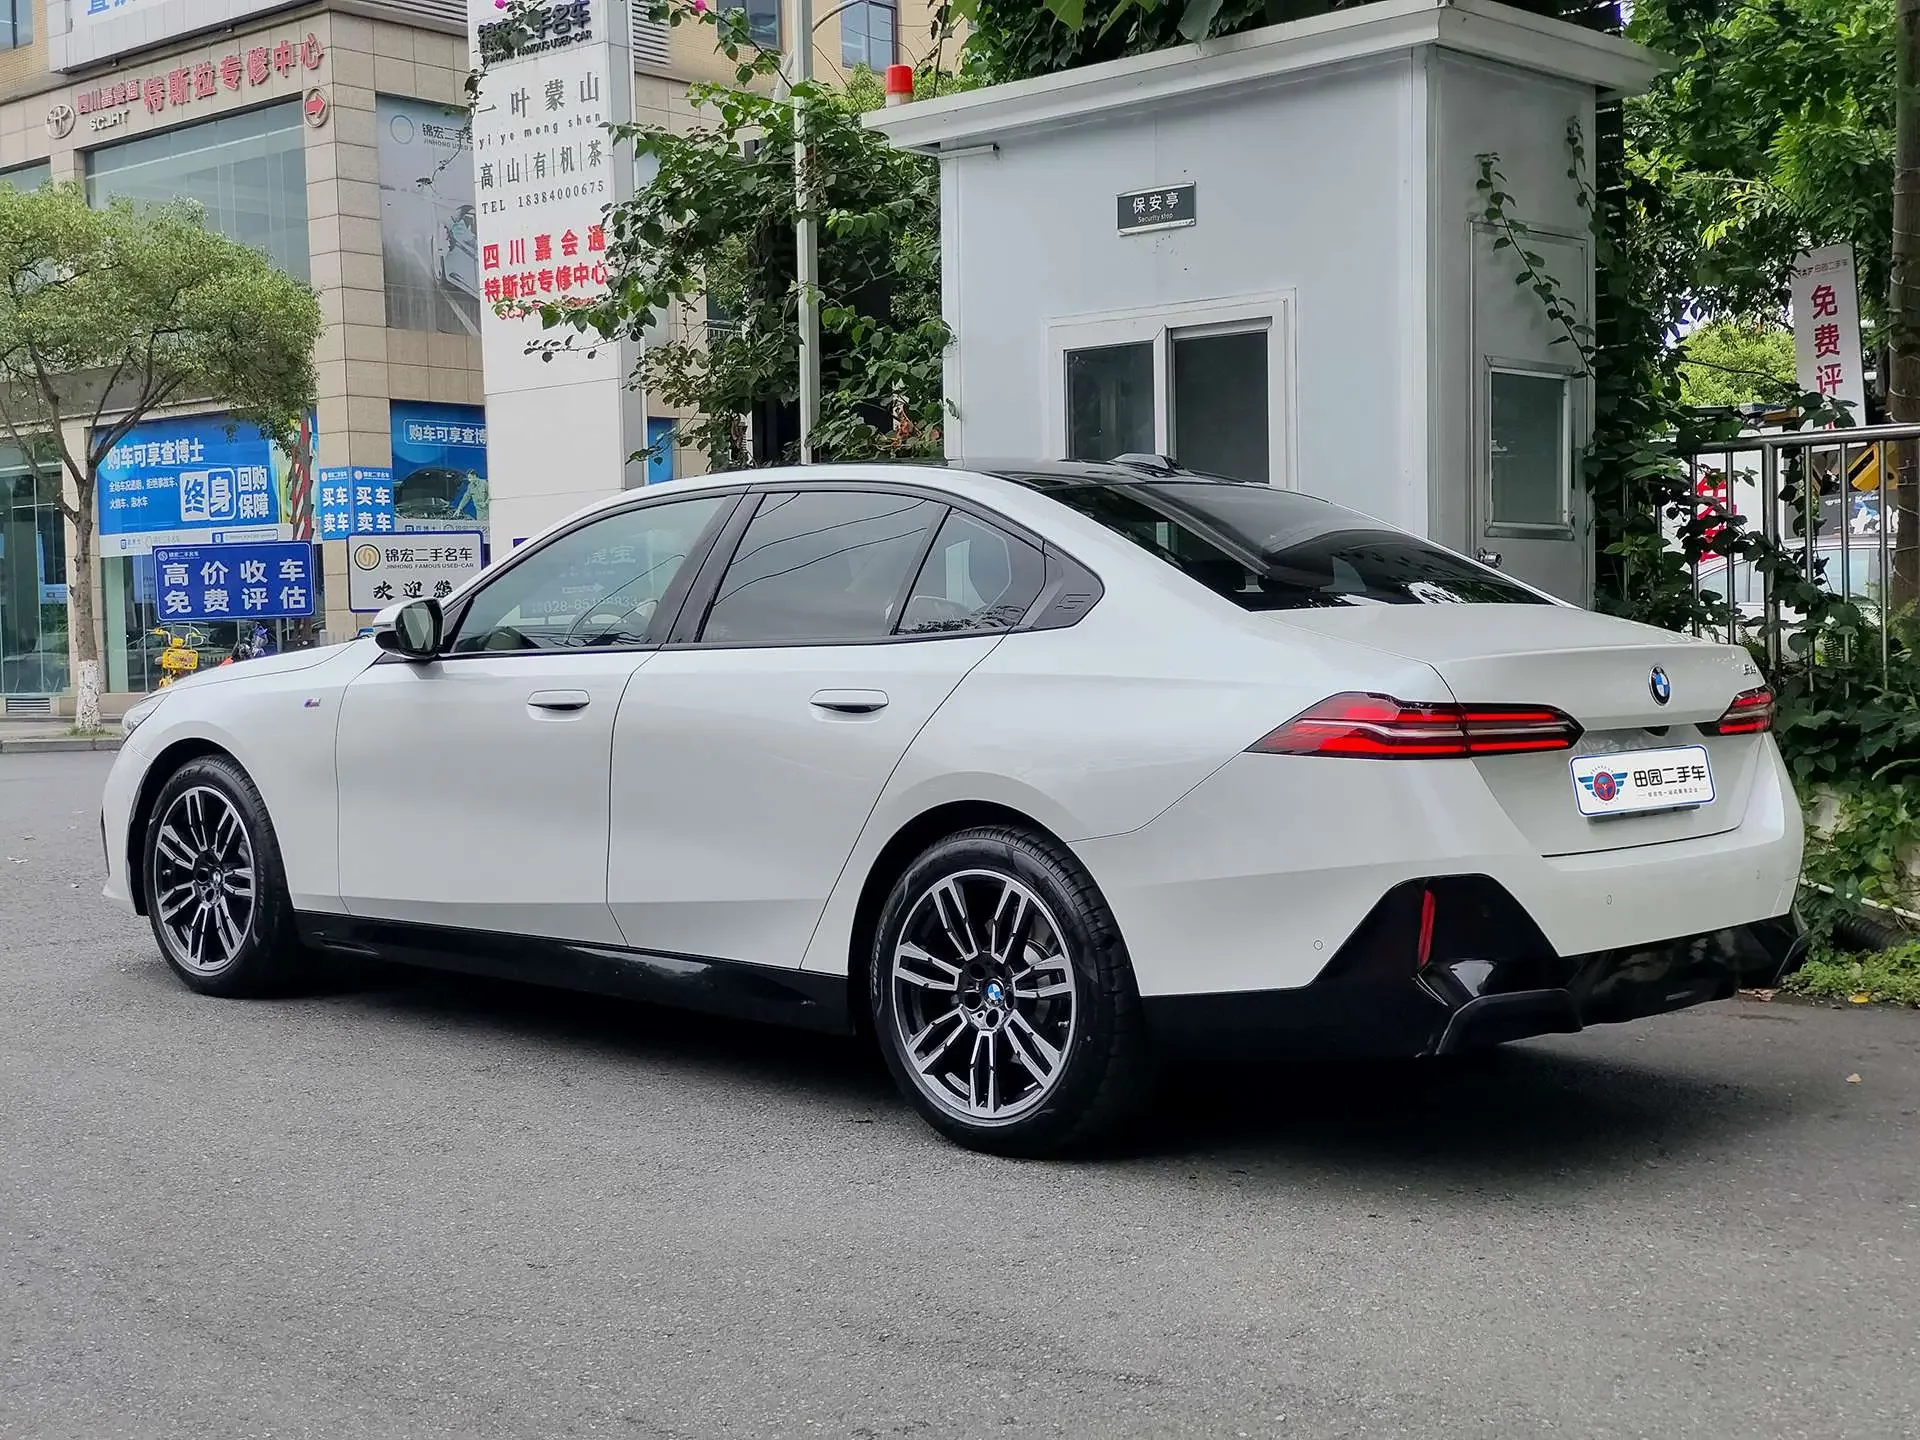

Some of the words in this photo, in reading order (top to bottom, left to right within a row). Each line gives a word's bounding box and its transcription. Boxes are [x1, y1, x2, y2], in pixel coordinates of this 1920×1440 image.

[143, 33, 324, 112] 特斯拉专修中心
[478, 72, 599, 118] 一叶蒙山
[482, 200, 506, 215] TEL
[518, 180, 604, 208] 18384000675
[1133, 191, 1179, 214] 保安亭
[483, 224, 606, 271] 四川嘉会通
[484, 260, 608, 303] 特斯拉专修中心
[1811, 284, 1843, 431] 免费评
[107, 438, 204, 470] 购车可享查博士
[237, 466, 267, 492] 回购
[184, 477, 232, 513] 终身
[238, 493, 269, 519] 保障
[322, 486, 349, 508] 买车
[356, 486, 391, 506] 买车
[323, 512, 350, 533] 卖车
[357, 512, 392, 532] 卖车
[385, 547, 473, 562] 锦宏二手名车
[162, 559, 306, 588] 高价收车
[164, 586, 306, 615] 免费评估
[373, 580, 453, 600] 欢迎您
[1633, 765, 1706, 787] 田园二手车
